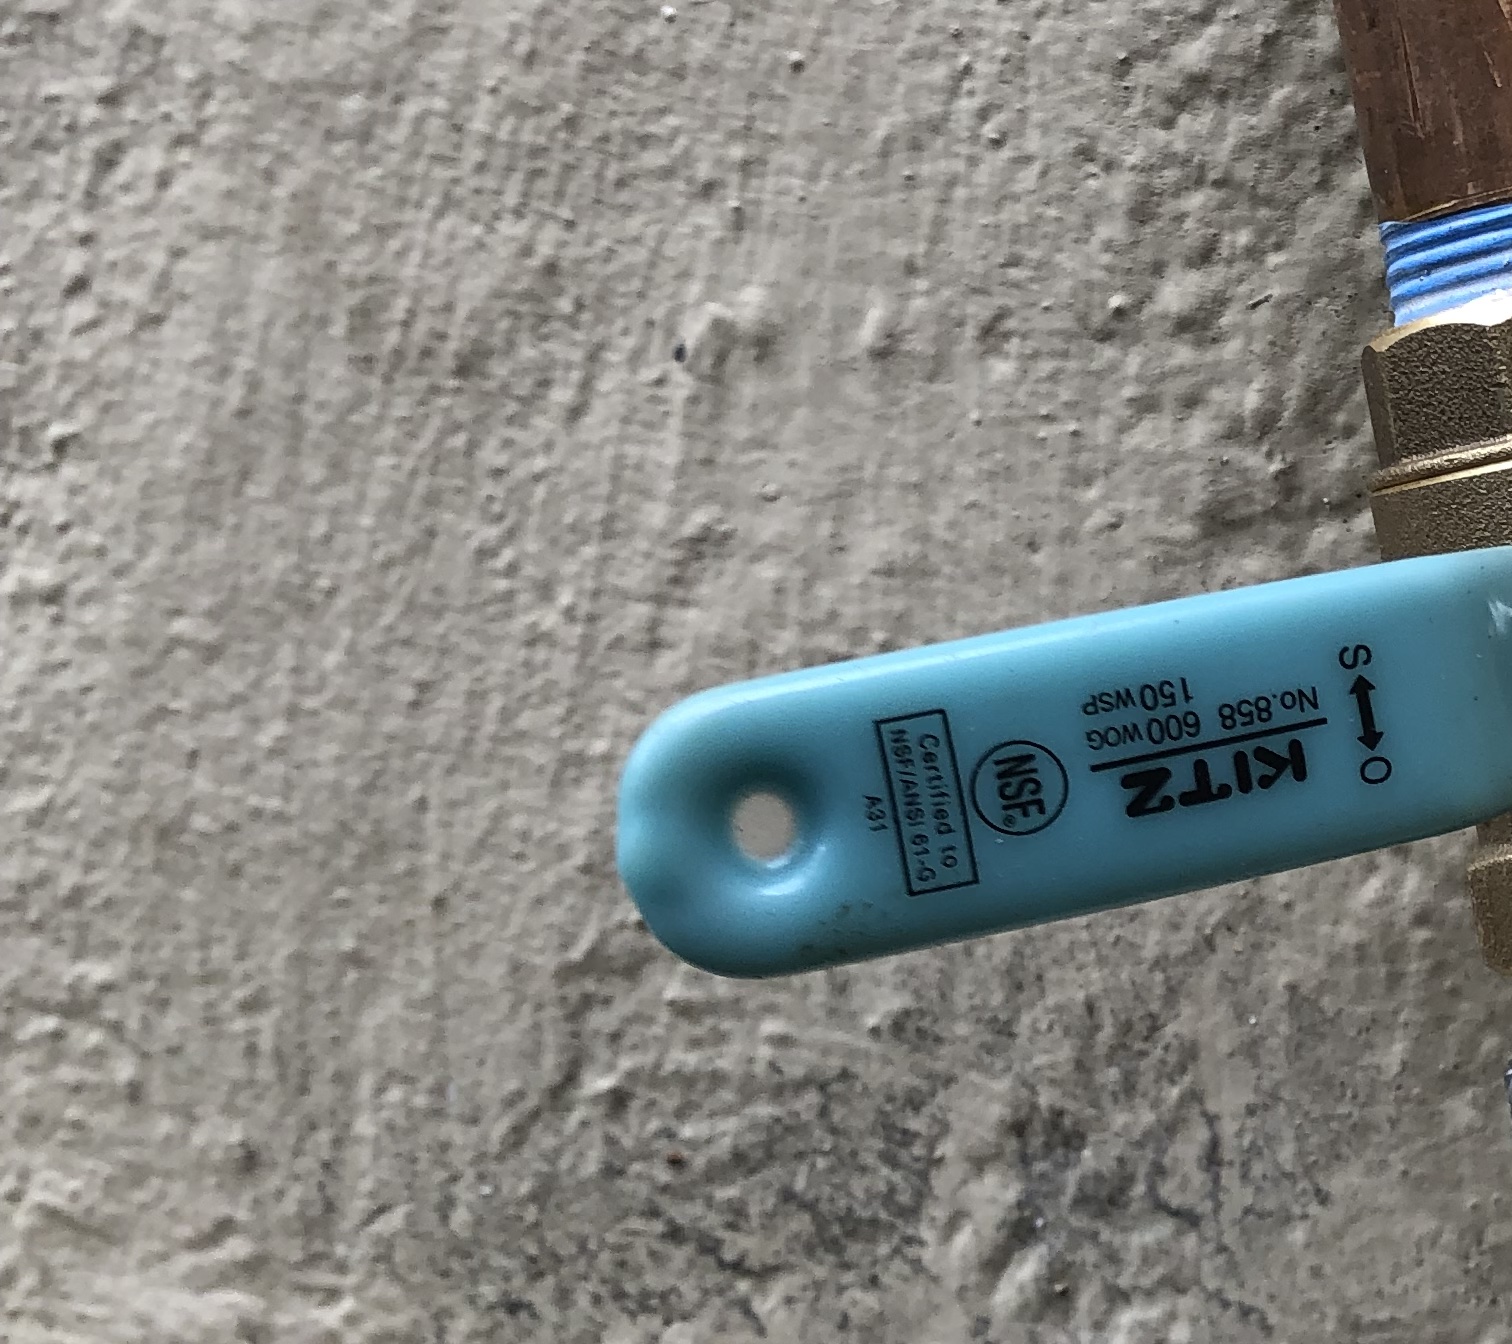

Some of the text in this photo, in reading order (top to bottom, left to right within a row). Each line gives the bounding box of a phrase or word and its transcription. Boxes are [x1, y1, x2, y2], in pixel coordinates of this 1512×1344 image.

[1338, 643, 1372, 670] S
[1082, 677, 1194, 715] 150 WSP
[1086, 686, 1320, 751] No.858 600 WOG
[919, 733, 958, 868] Certified to
[1121, 738, 1307, 817] KITZ
